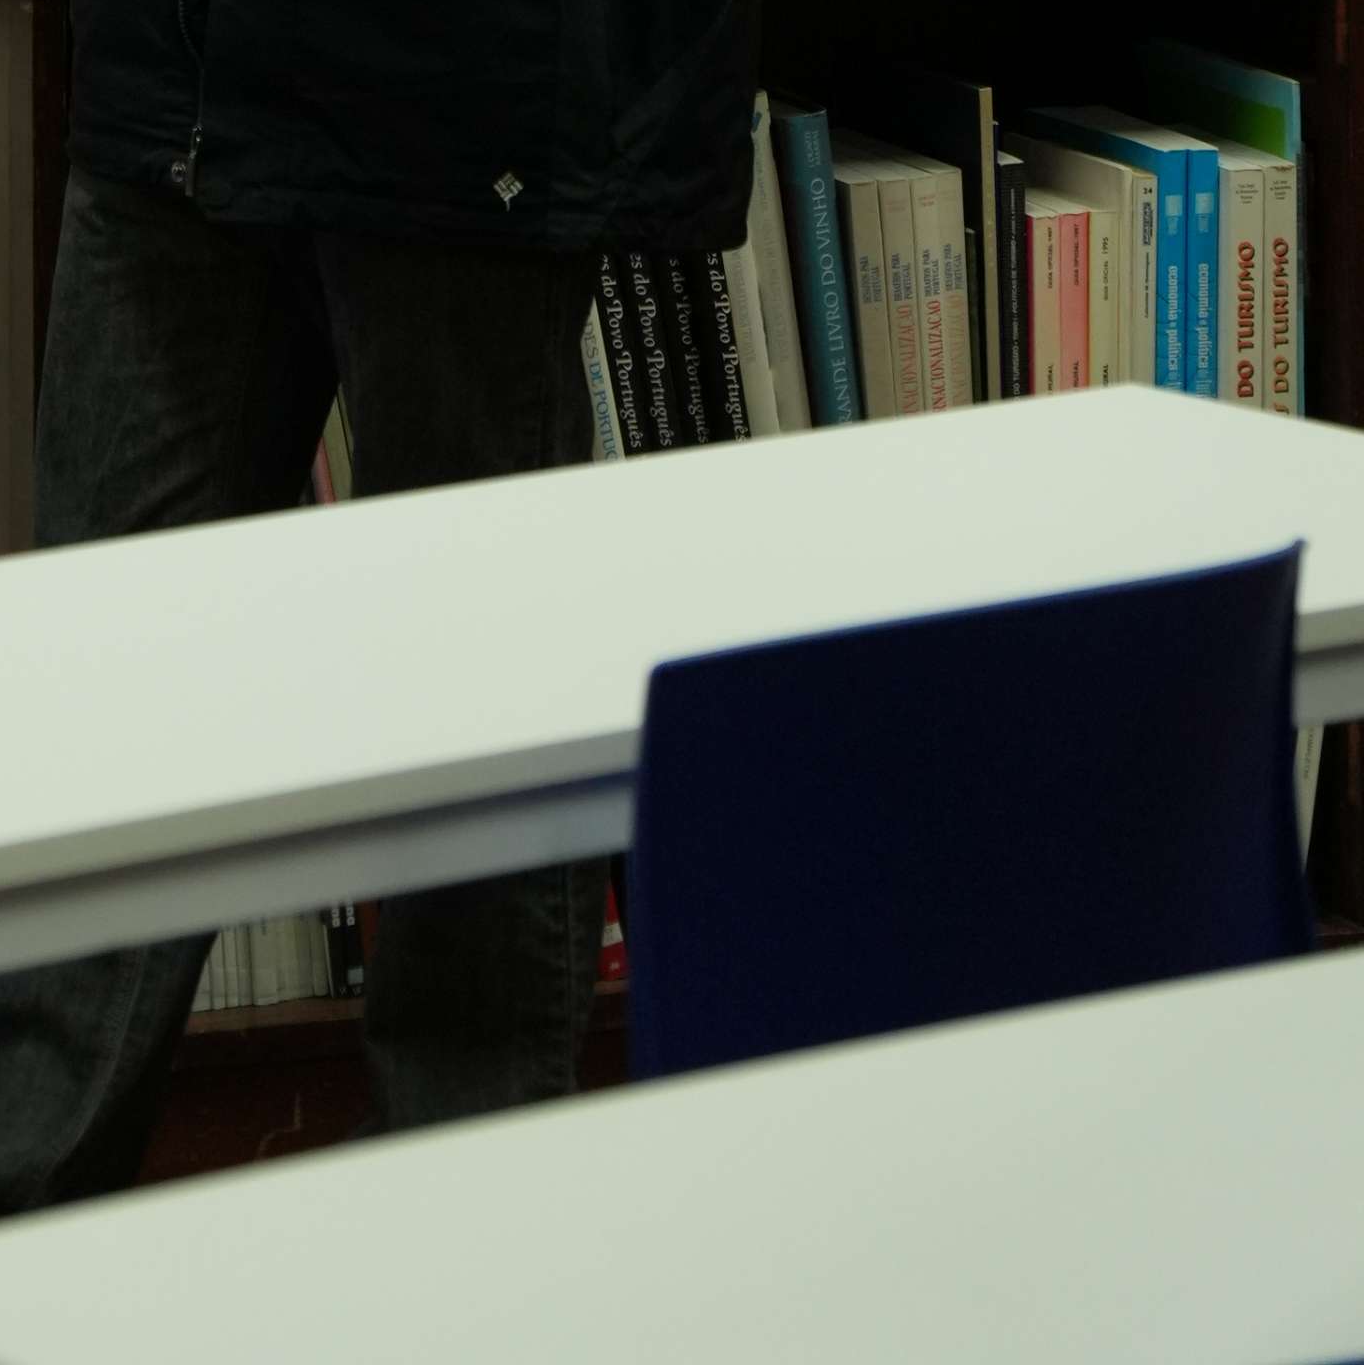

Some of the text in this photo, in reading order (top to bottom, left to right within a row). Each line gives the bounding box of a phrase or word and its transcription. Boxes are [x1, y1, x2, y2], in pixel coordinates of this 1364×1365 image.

[809, 177, 832, 251] VINHO
[600, 275, 617, 299] do
[819, 253, 836, 286] DO
[1168, 265, 1181, 320] economia
[1198, 261, 1211, 319] economia
[606, 299, 625, 350] Povo
[823, 291, 846, 350] LIVRO
[1236, 241, 1255, 399] DO TURISMO
[1271, 237, 1290, 394] DO TURISMO
[632, 273, 675, 447] do Povo Português
[670, 271, 710, 444] do Povo Português
[708, 269, 748, 443] do Povo Português
[619, 351, 644, 449] Português
